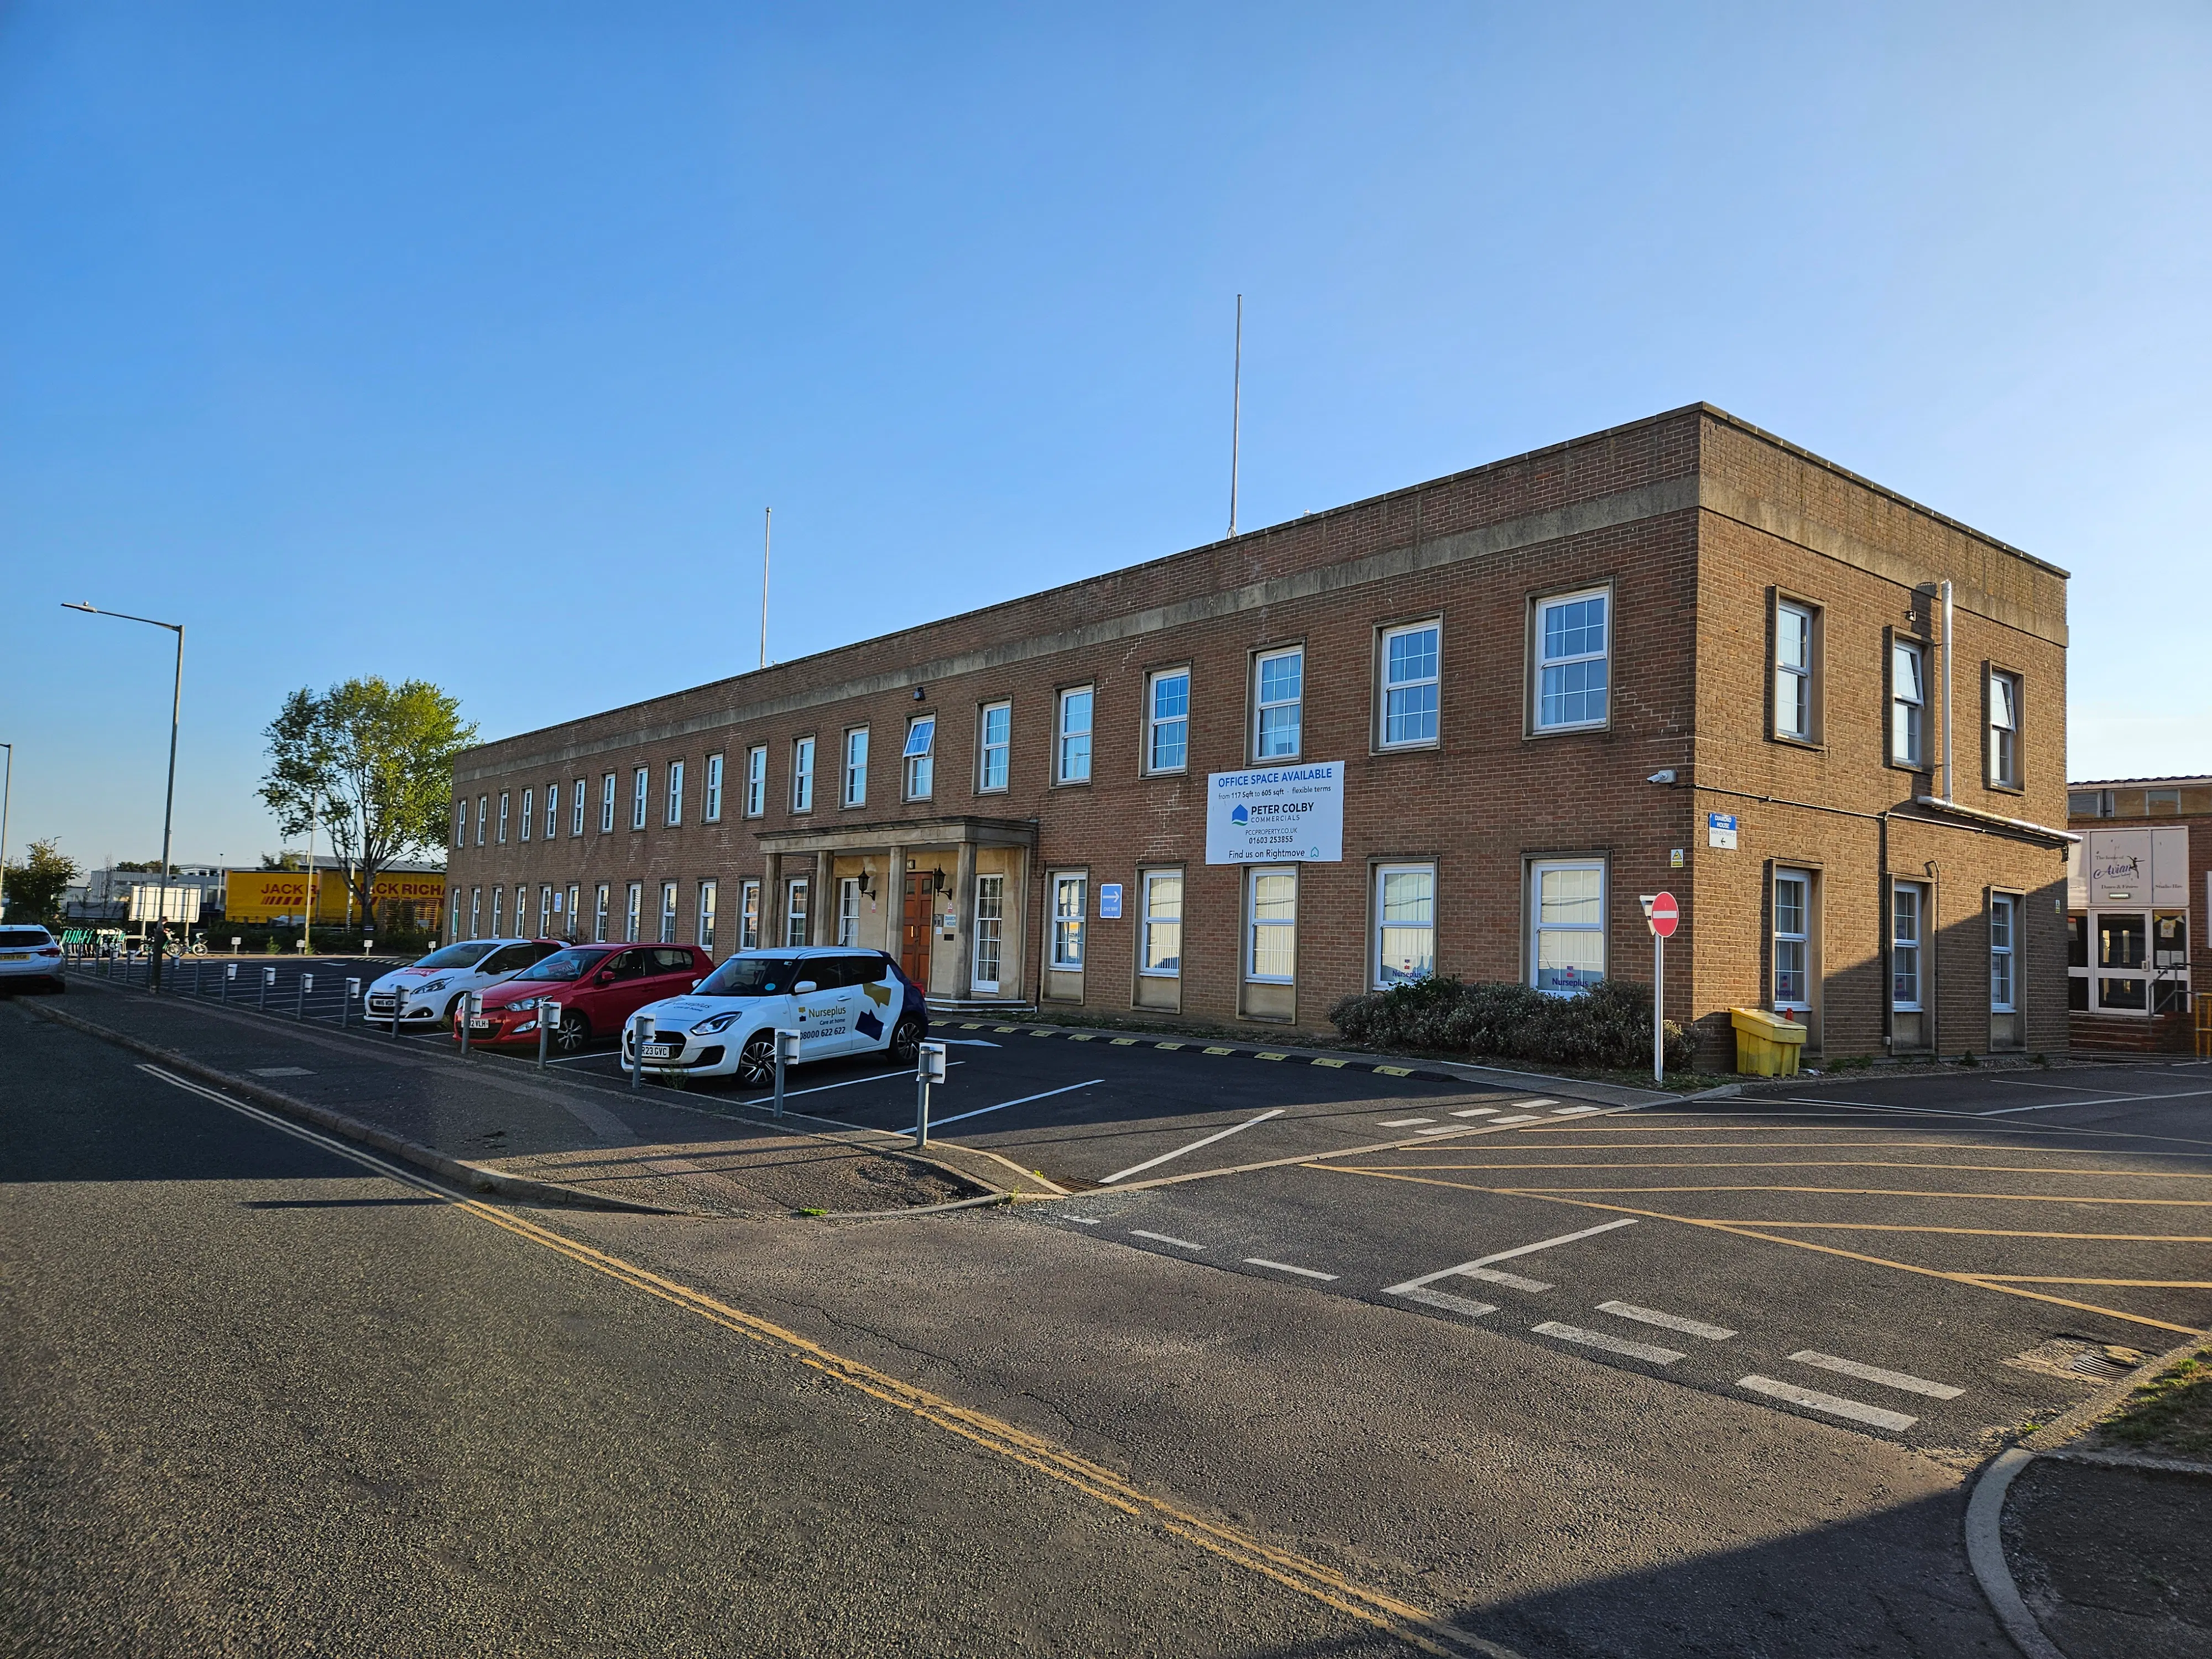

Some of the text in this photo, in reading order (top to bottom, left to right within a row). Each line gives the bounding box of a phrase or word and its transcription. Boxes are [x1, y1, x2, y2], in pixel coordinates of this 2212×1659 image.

[1218, 768, 1332, 787] OFFICE SPACE AVAILABLE
[1242, 790, 1254, 799] Sqft
[1273, 788, 1284, 797] sqft
[1292, 786, 1313, 794] flexible
[1251, 802, 1314, 815] PETER COLBY
[1251, 815, 1300, 823] COMMERCIALS
[1245, 827, 1298, 836] PCCPROPERTY.CO.UK
[1229, 849, 1244, 858] Find
[1266, 848, 1305, 860] Rightmove
[2093, 864, 2131, 879] Avian
[261, 884, 304, 894] JACK
[1392, 970, 1422, 979] Nurseplus
[1552, 978, 1589, 988] Nurseplus
[808, 1005, 846, 1018] Nurseplus
[800, 1026, 846, 1040] 08000 622 622
[641, 1046, 667, 1056] R23 GVC
